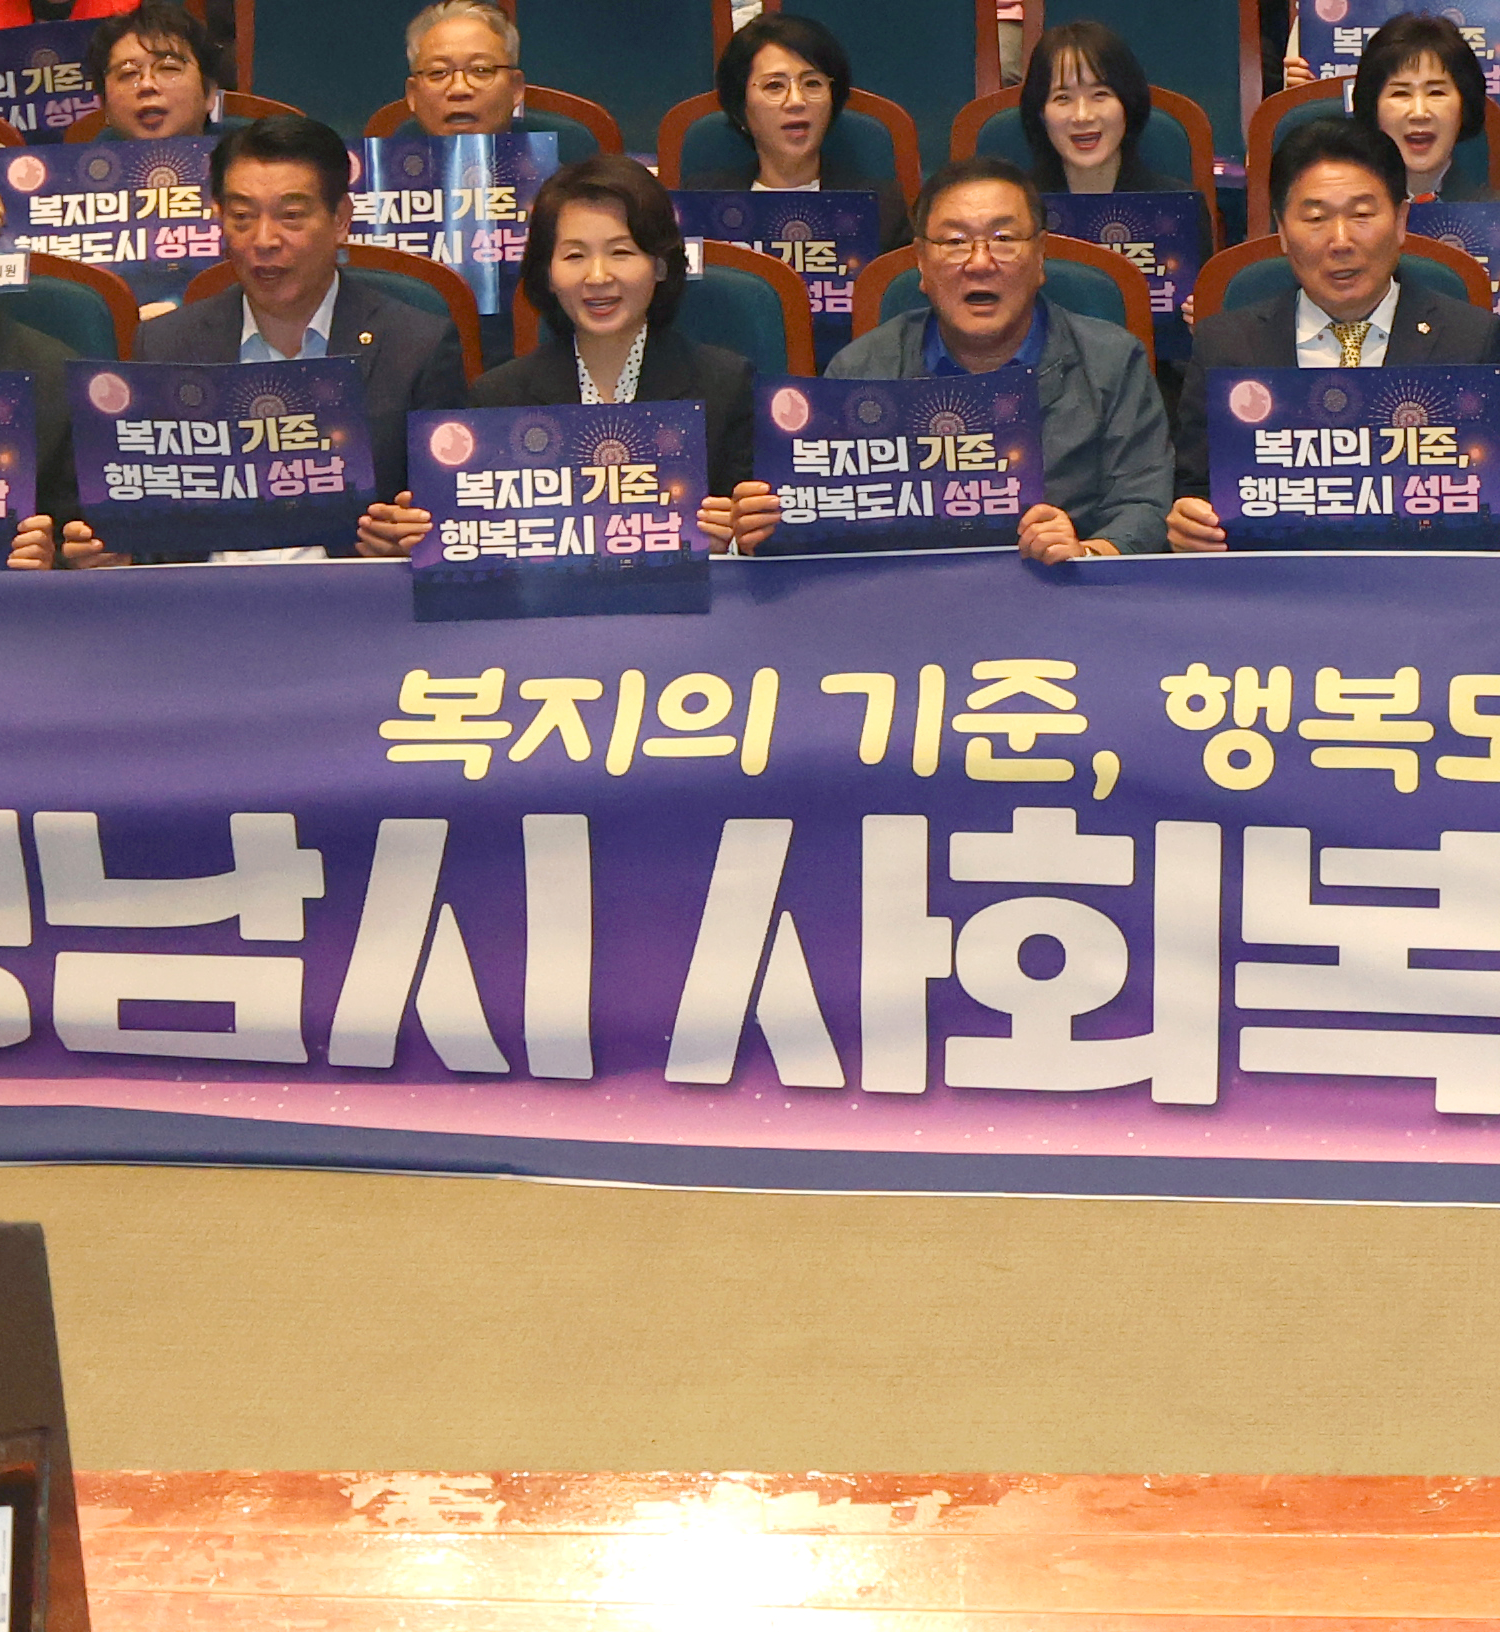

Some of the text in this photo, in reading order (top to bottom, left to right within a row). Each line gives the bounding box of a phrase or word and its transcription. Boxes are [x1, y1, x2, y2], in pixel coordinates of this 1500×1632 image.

[116, 414, 330, 455] 복지의 기준,
[793, 434, 1007, 476] 복지의 기준,
[1256, 427, 1469, 468] 복지의 기준,
[104, 457, 344, 500] 행복도시 성남
[457, 465, 670, 509] 복지의 기준,
[777, 478, 1020, 520] 행복도시 성남
[1239, 475, 1480, 516] 행복도시 성남
[440, 512, 681, 560] 행복도시 성남
[379, 667, 779, 781] 복지의
[820, 659, 1120, 800] 기준,
